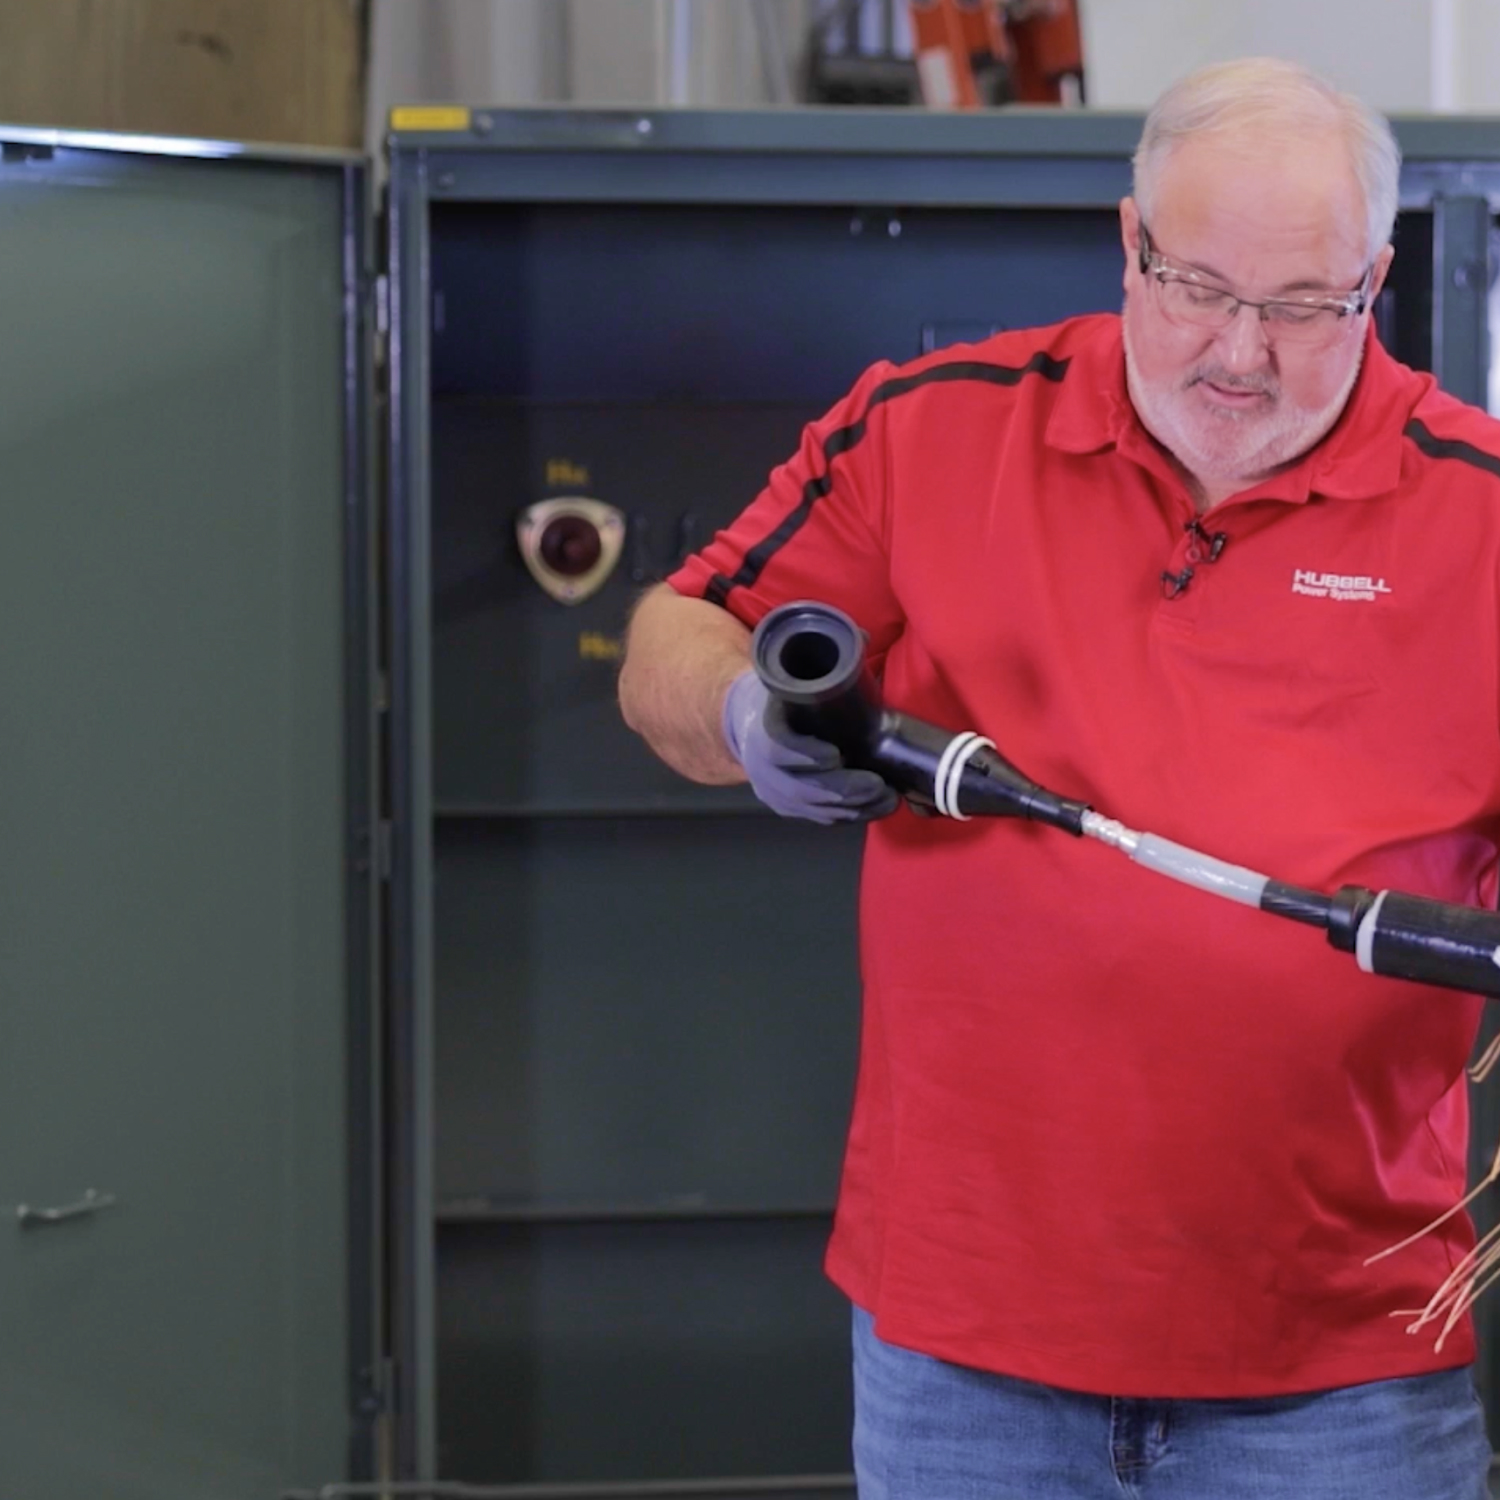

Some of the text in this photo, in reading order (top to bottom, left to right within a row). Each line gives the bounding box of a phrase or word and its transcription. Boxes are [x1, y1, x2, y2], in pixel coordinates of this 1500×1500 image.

[1292, 582, 1376, 601] Power Systems
[1293, 568, 1392, 593] HUBBELL
